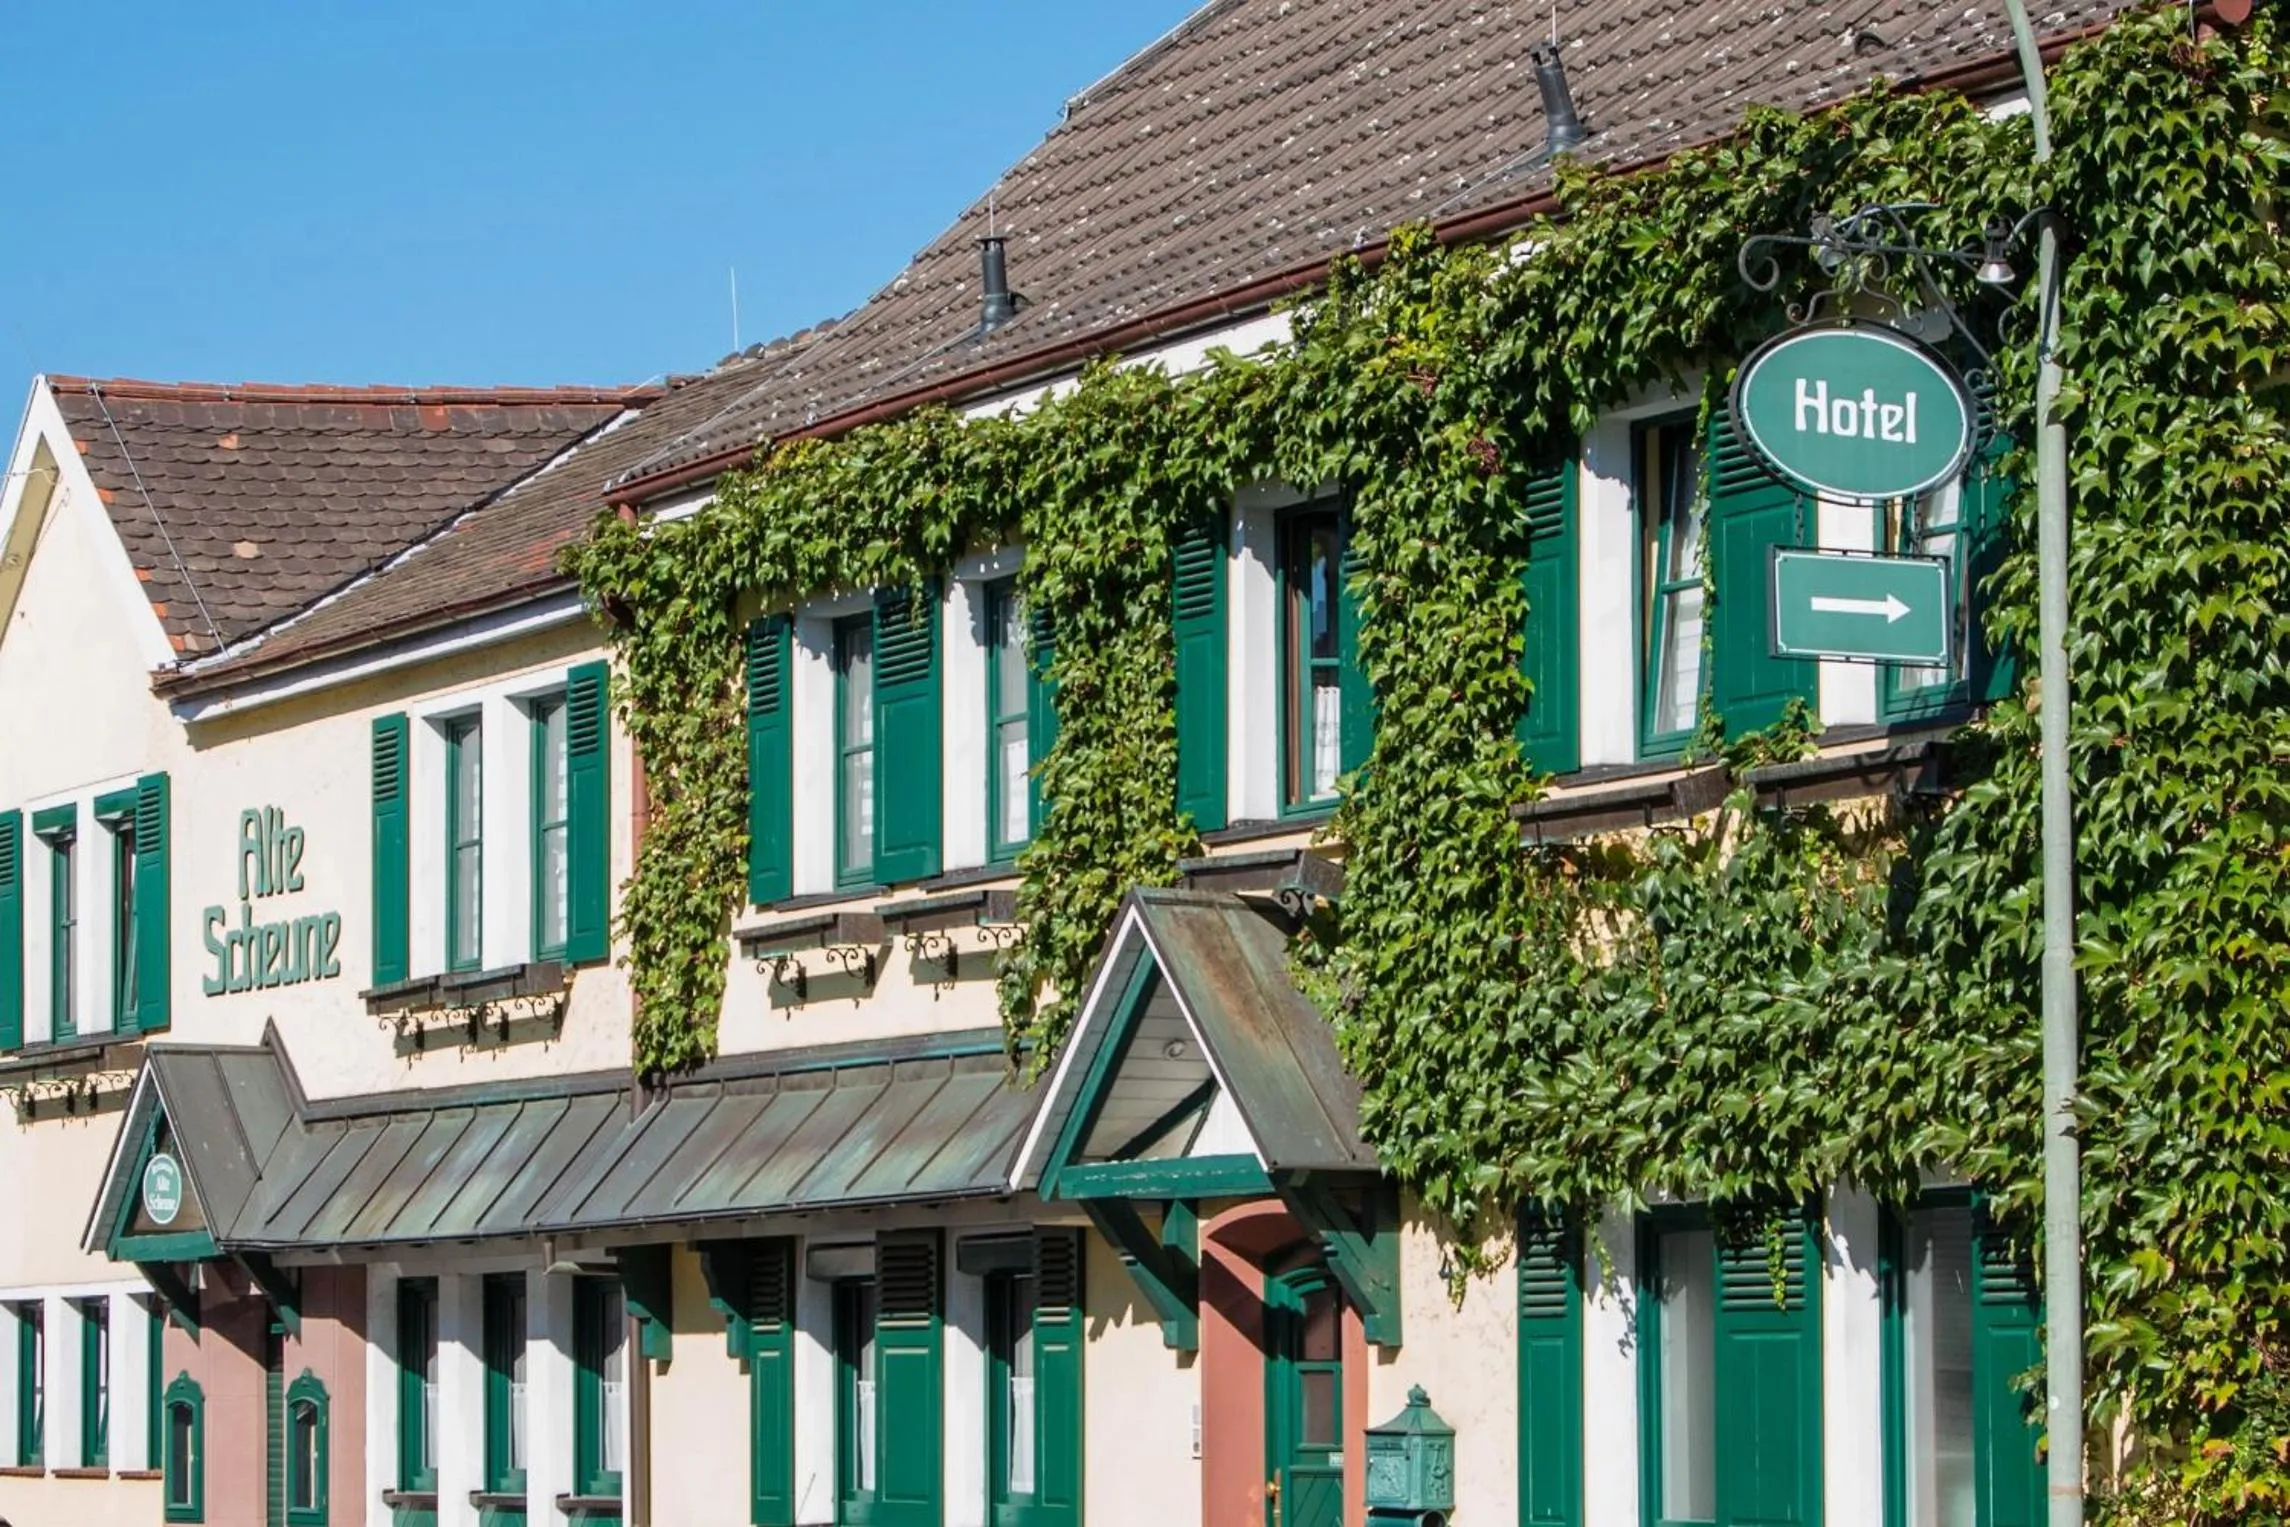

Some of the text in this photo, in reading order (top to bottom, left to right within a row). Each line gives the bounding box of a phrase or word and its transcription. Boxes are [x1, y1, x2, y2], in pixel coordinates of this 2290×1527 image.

[1795, 378, 1916, 444] Hotel
[239, 804, 304, 900] Alte
[203, 902, 341, 997] Scheune
